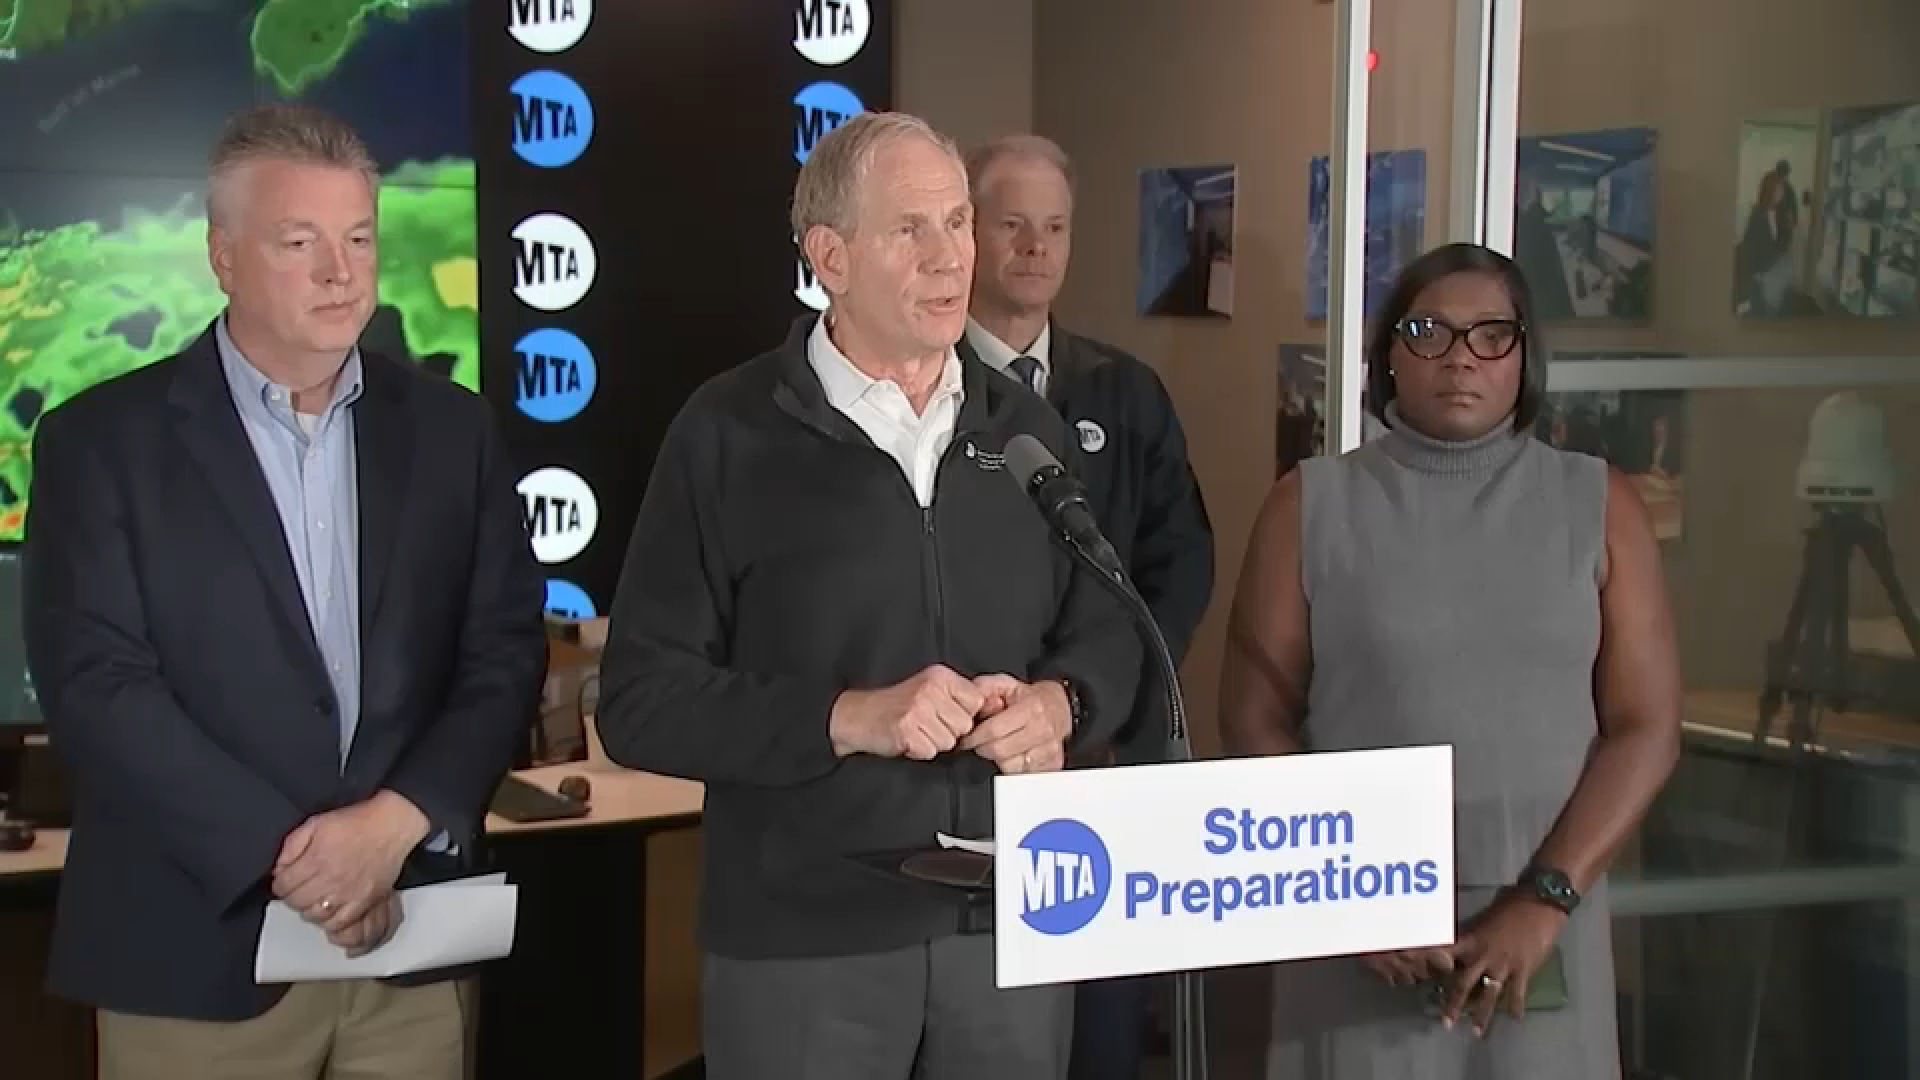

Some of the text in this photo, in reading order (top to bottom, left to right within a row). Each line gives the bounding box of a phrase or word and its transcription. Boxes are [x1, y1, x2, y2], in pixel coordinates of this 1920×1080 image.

[794, 0, 854, 41] MTA
[511, 93, 578, 144] MTA
[793, 104, 851, 153] MT
[512, 238, 580, 288] MTA
[515, 351, 582, 400] MTA
[518, 491, 581, 538] MTA
[1203, 807, 1355, 856] Storm
[1020, 847, 1097, 912] MTA
[1124, 854, 1439, 922] Preparations
